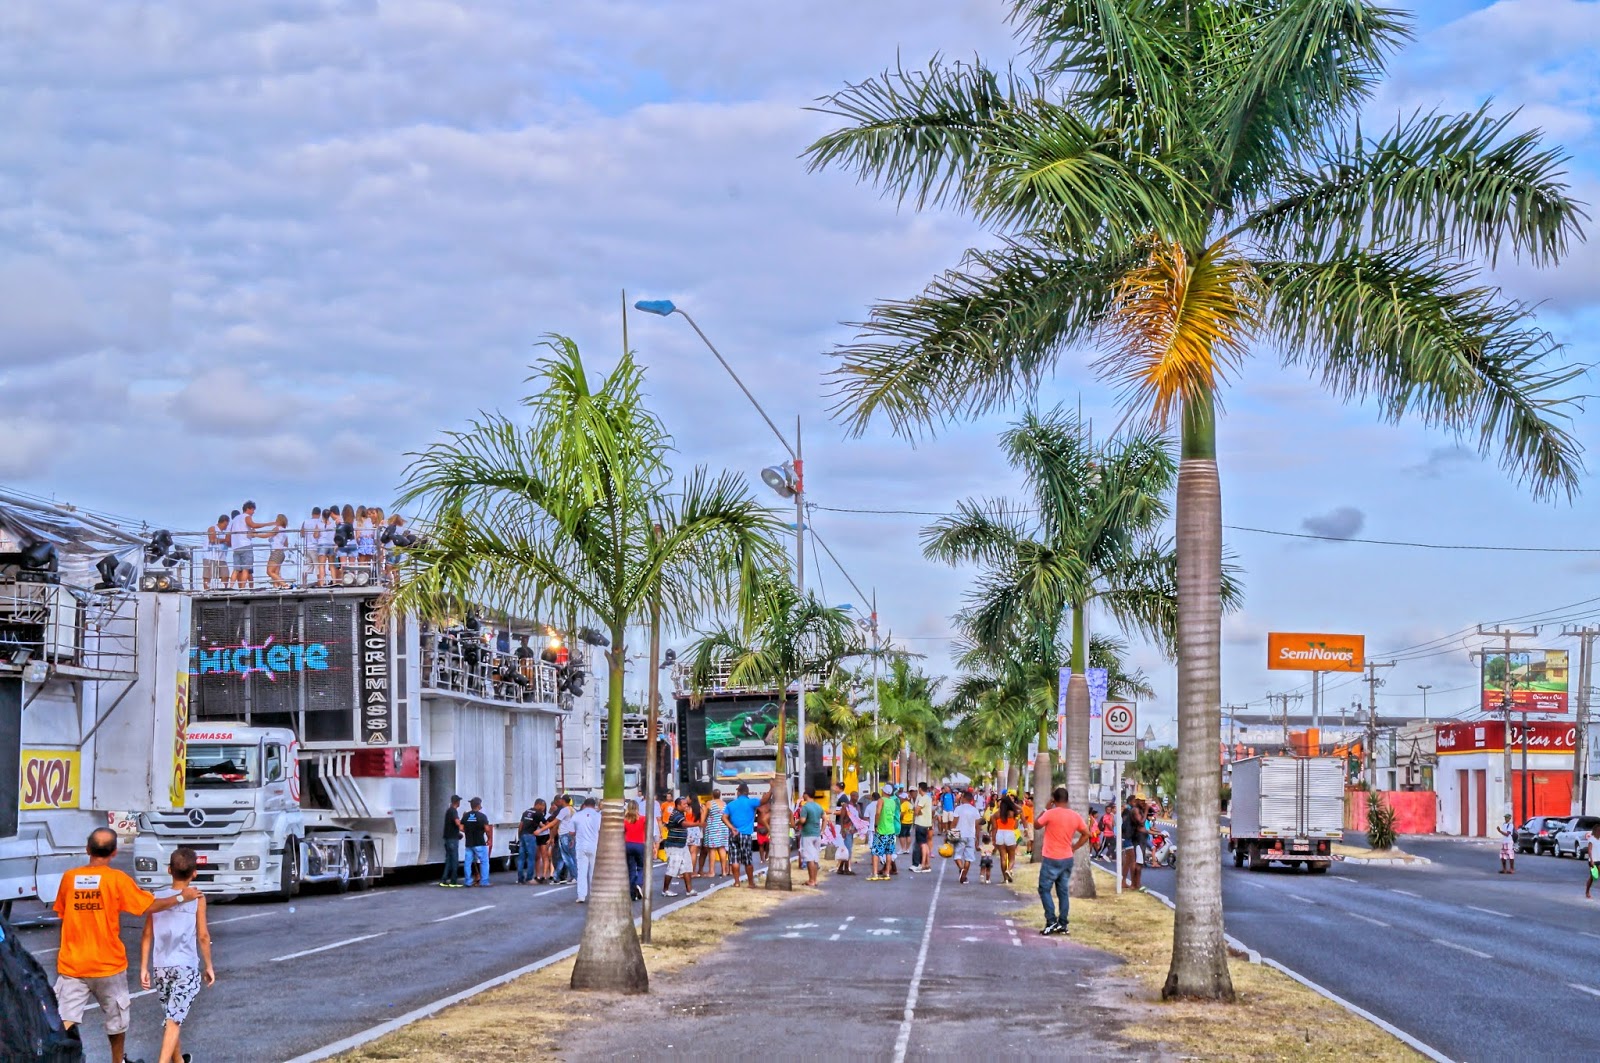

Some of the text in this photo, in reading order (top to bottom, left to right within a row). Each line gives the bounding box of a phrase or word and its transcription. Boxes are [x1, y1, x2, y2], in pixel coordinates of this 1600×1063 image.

[175, 681, 187, 760] SKOL
[1110, 711, 1127, 723] 60
[25, 758, 73, 807] SKOL
[74, 891, 101, 900] STAFF
[74, 903, 103, 911] SECEL
